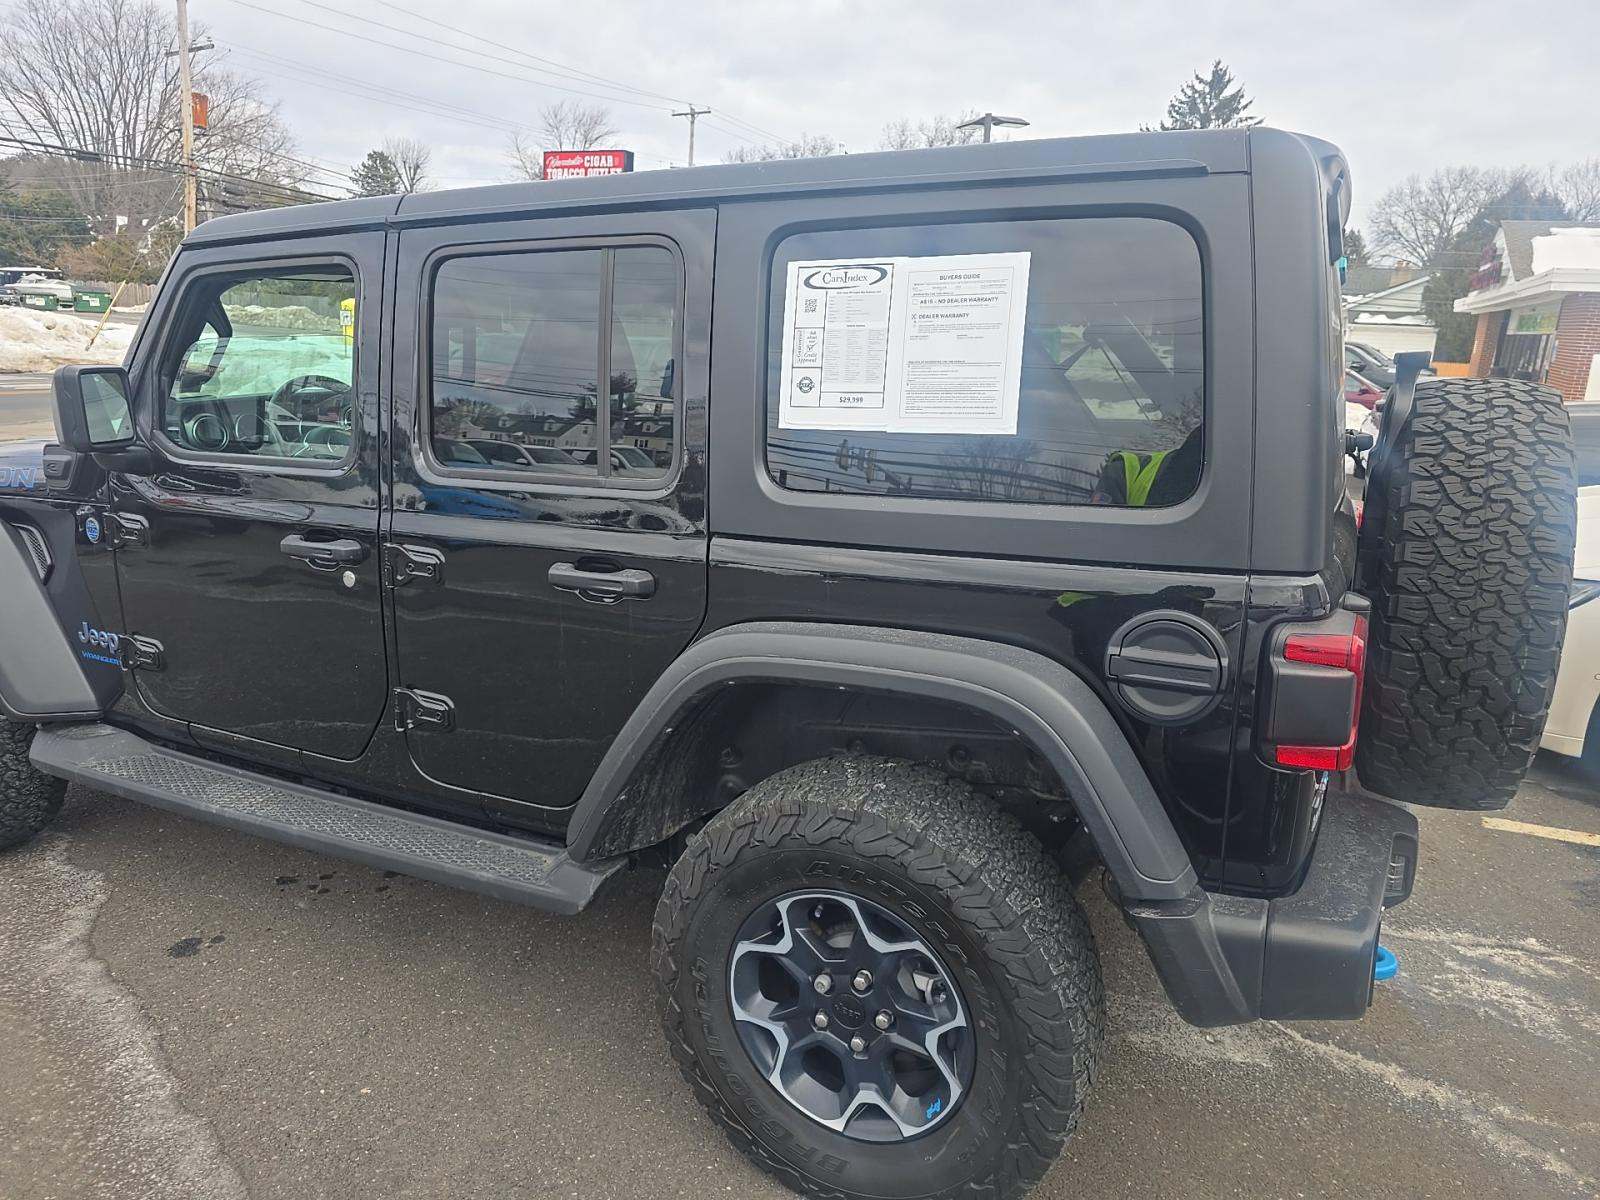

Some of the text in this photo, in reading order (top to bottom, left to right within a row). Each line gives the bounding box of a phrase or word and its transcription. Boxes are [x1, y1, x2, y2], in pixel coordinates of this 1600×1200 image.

[584, 155, 613, 167] CIGAR
[546, 167, 585, 180] TOBACCO
[822, 271, 868, 284] CarsIndex
[78, 621, 119, 655] Jeep
